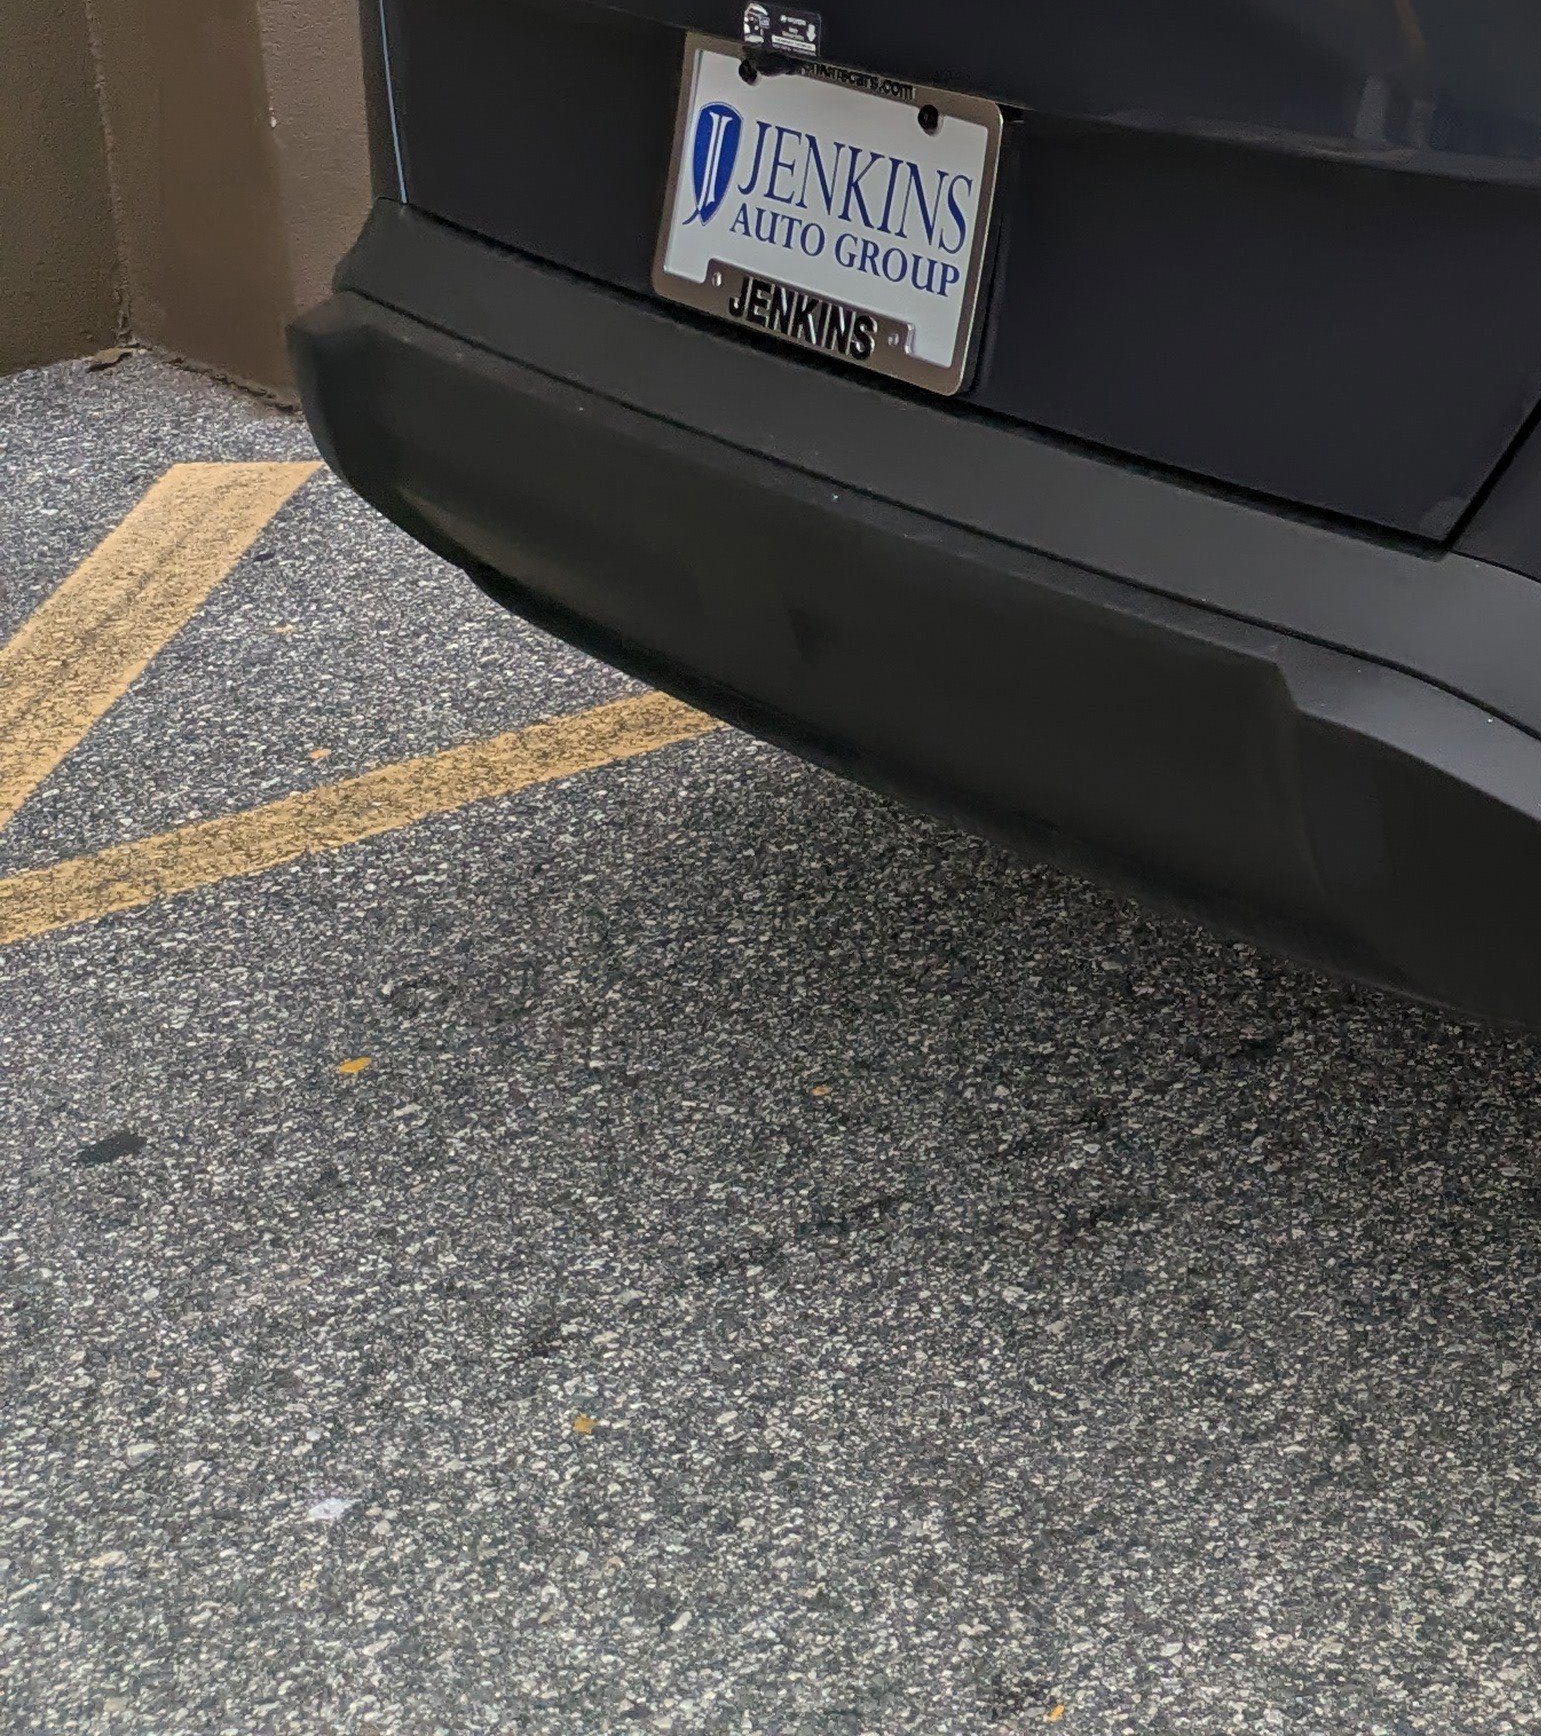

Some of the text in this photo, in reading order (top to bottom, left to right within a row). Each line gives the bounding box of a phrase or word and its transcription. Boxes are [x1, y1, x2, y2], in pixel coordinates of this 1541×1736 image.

[738, 120, 973, 255] JENKINS
[729, 202, 961, 298] AUTO GROUP
[728, 276, 879, 361] JENKINS
